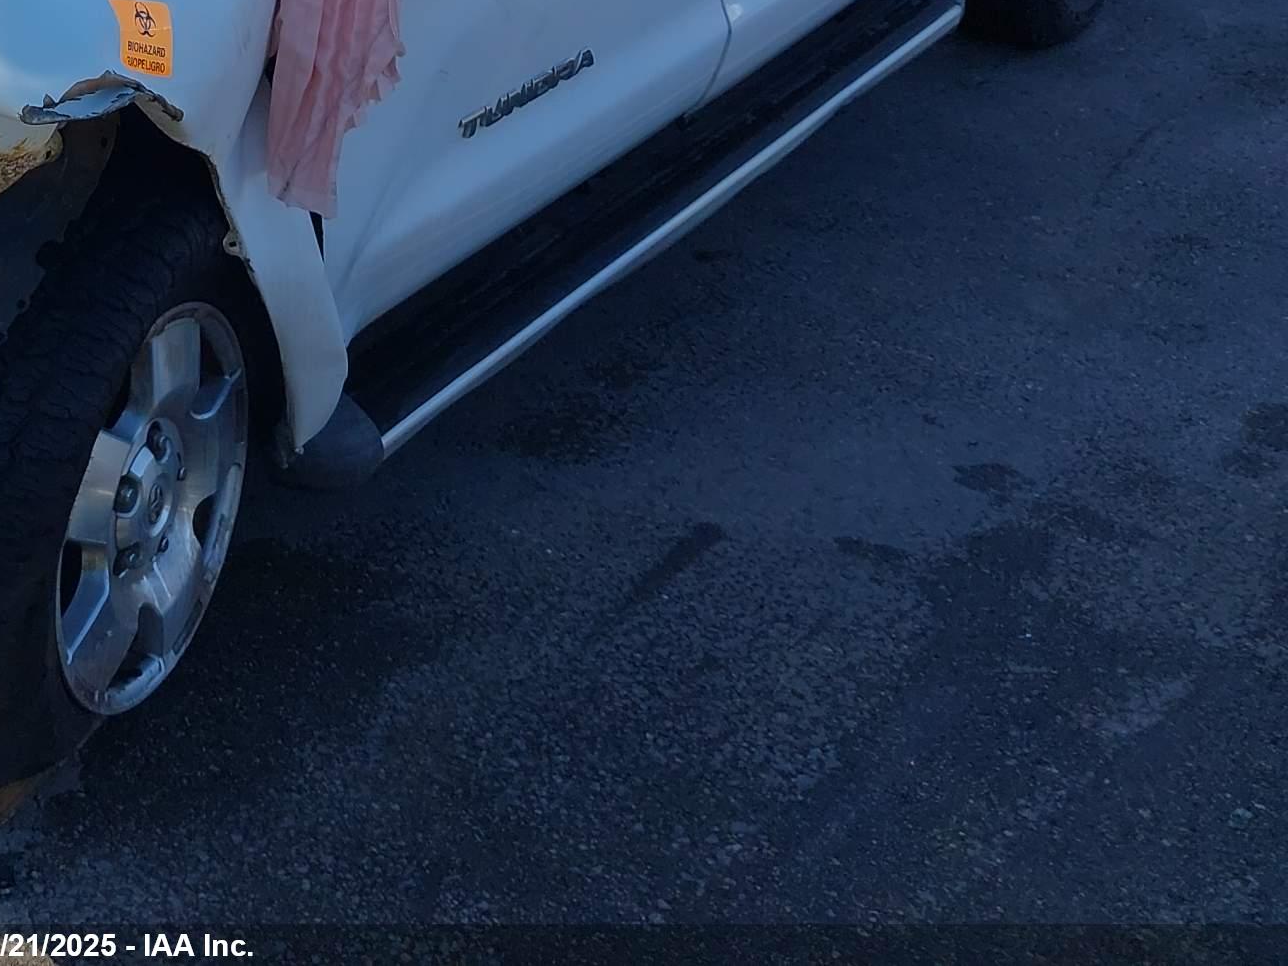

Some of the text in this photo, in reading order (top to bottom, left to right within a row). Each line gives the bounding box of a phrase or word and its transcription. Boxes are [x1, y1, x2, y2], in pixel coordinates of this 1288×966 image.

[127, 40, 166, 58] BIOHAZARD
[127, 56, 166, 74] BIOPELIGRO
[457, 48, 595, 139] TUNDRA
